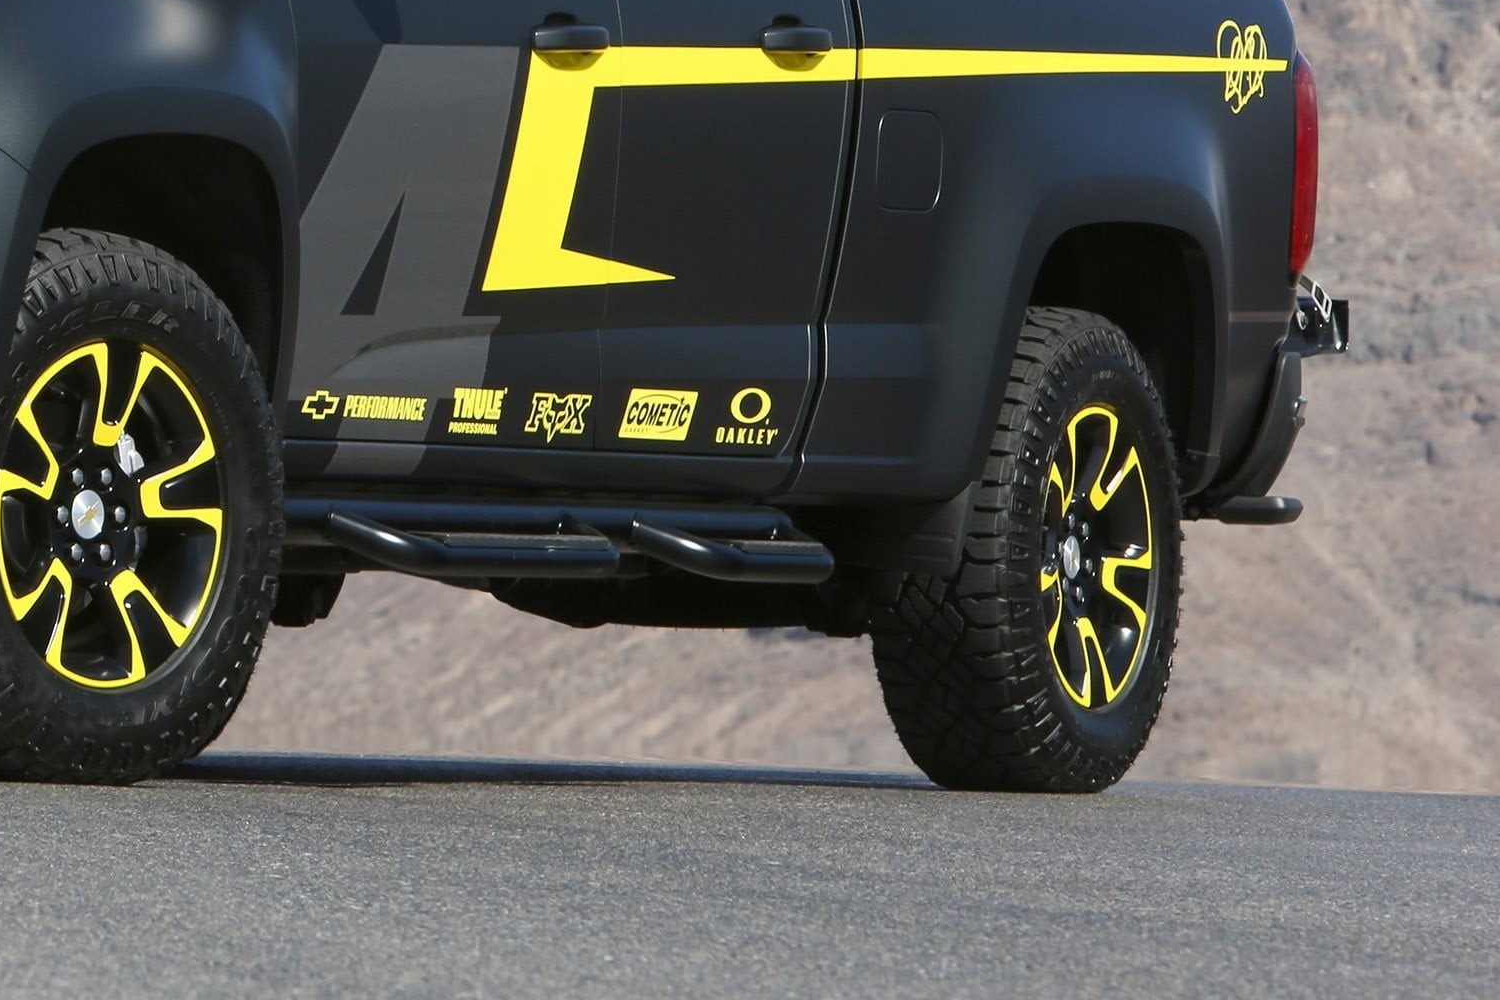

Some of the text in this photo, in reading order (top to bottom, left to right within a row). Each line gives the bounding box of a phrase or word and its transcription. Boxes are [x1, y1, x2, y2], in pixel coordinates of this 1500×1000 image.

[342, 394, 428, 421] PERFORMANCE
[453, 387, 505, 420] THULE
[524, 392, 593, 443] FOX
[626, 396, 692, 428] COMETIC
[448, 421, 498, 435] PROFESSIONAL
[715, 426, 774, 445] OAKLEY
